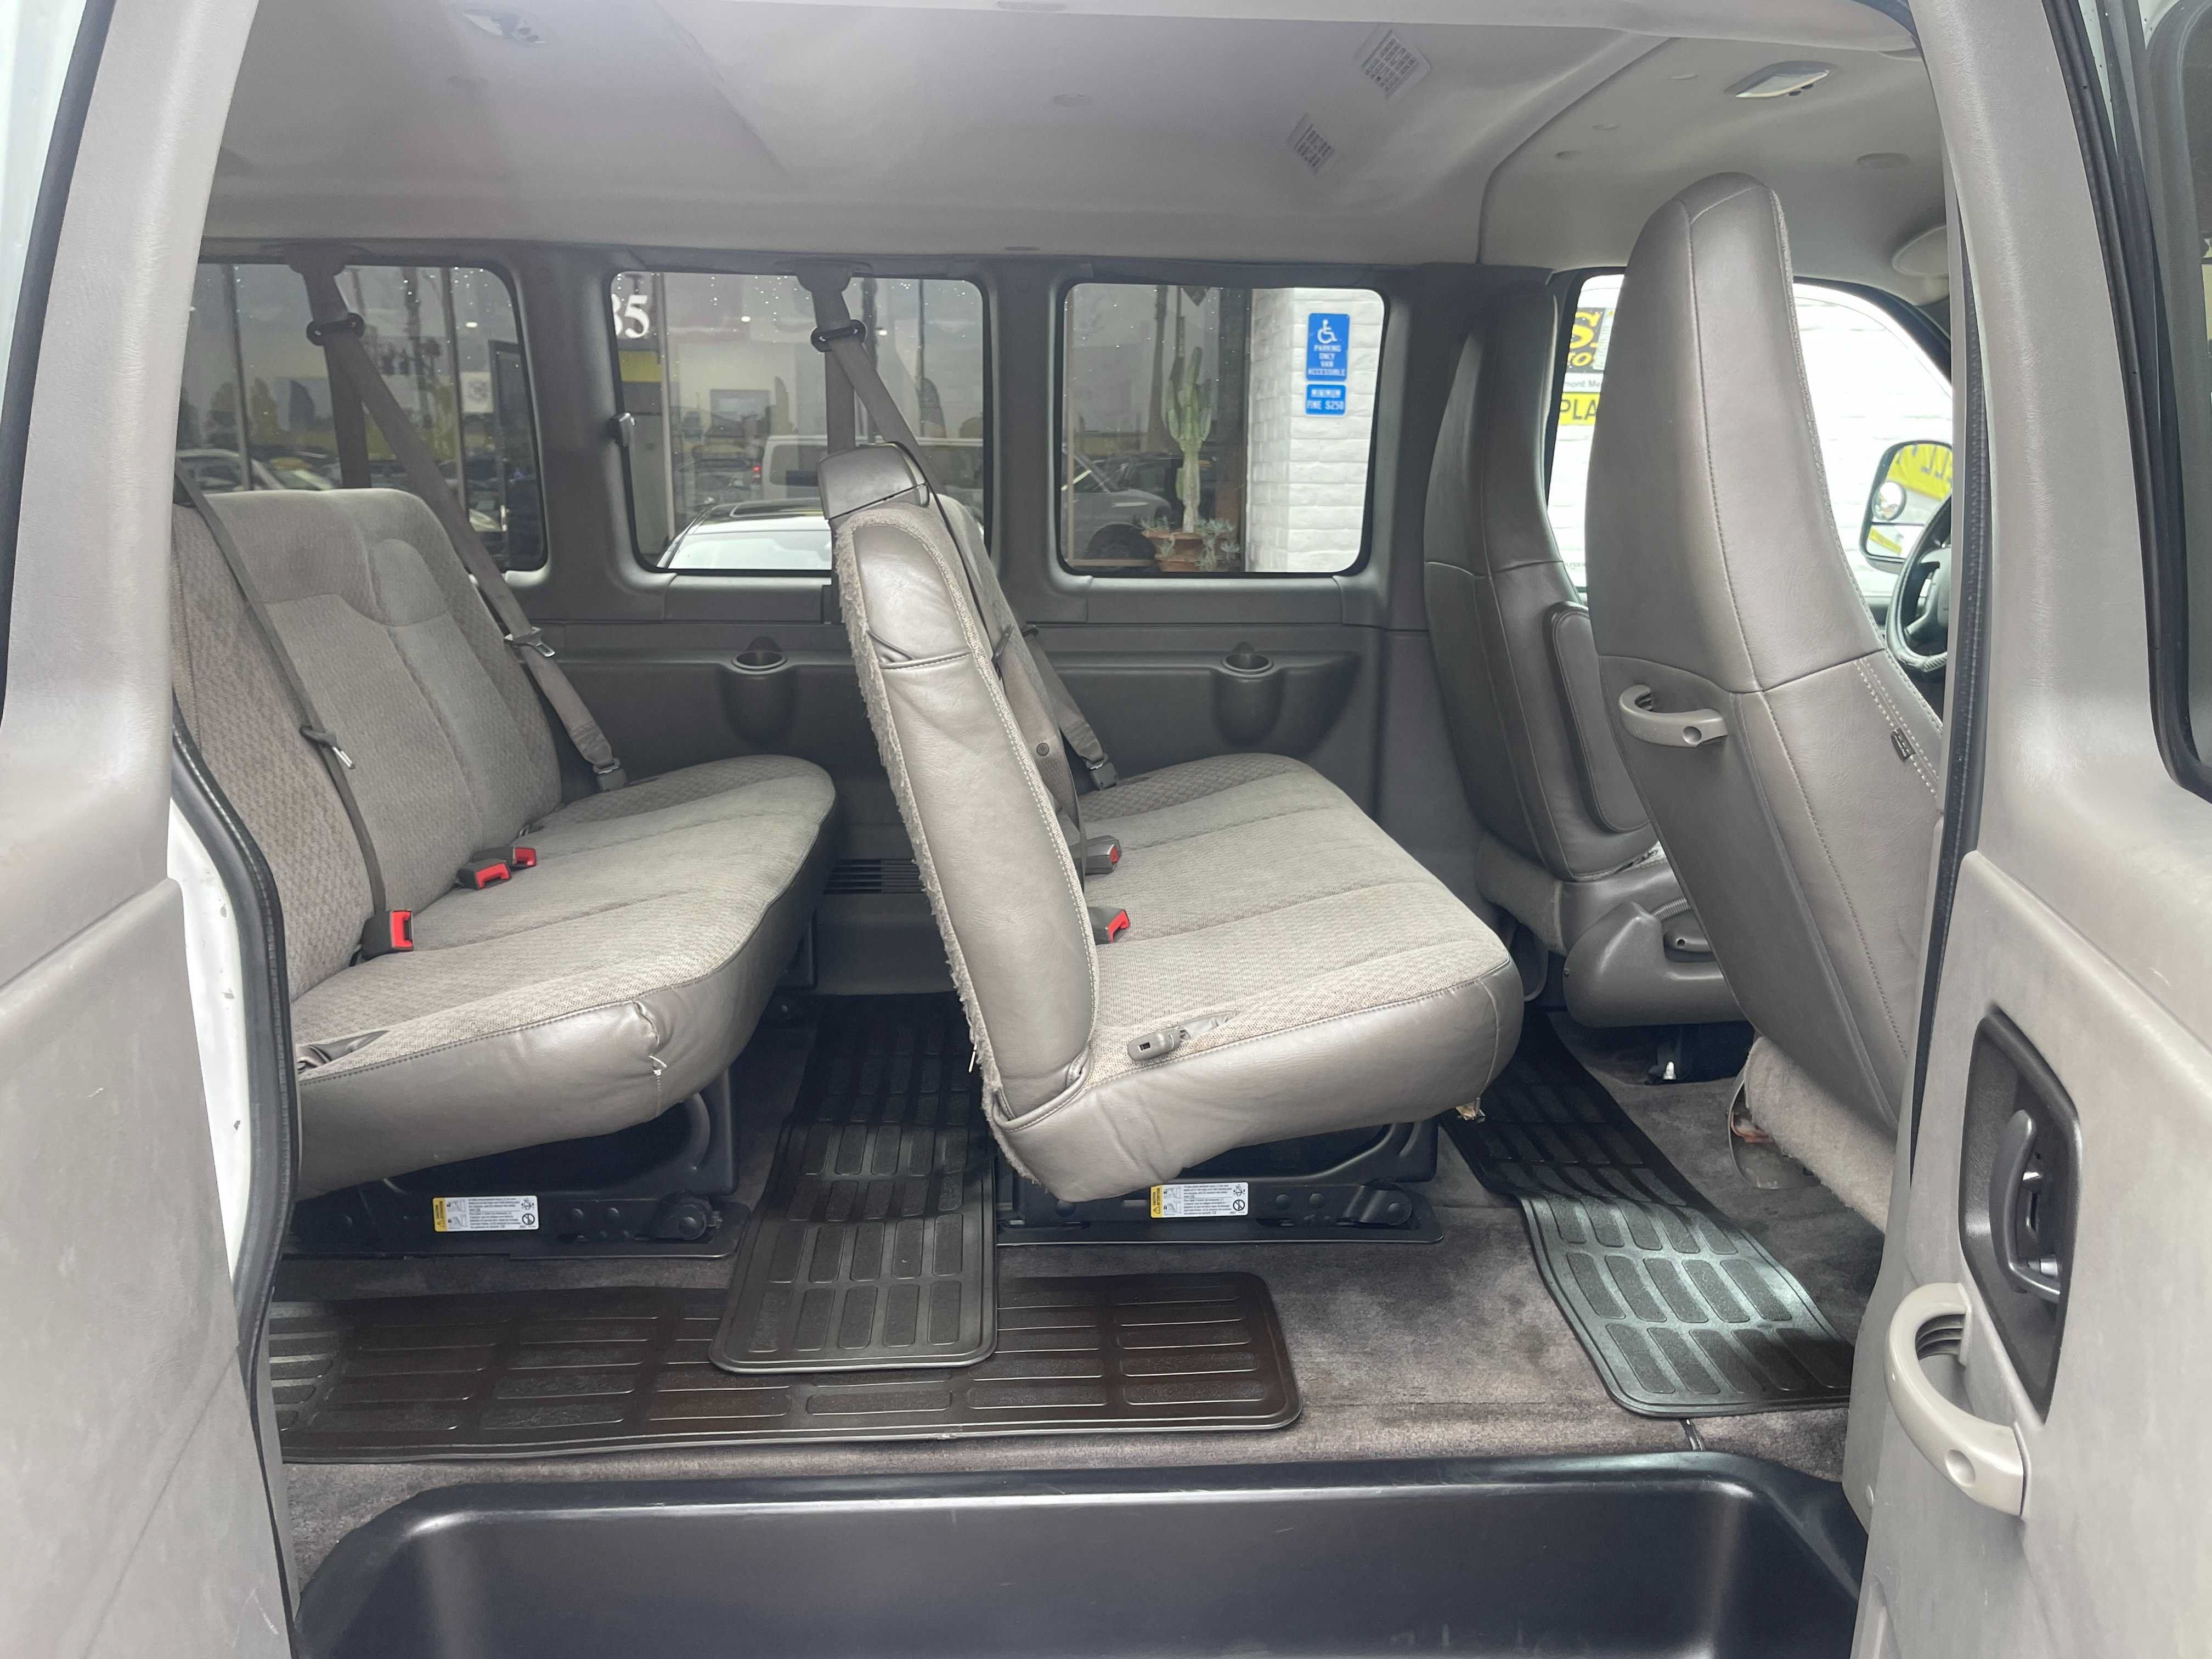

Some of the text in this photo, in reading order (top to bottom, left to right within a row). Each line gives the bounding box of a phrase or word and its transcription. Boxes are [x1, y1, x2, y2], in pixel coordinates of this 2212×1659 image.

[1311, 389, 1342, 398] MINIMUM
[1307, 400, 1344, 410] FINE $250
